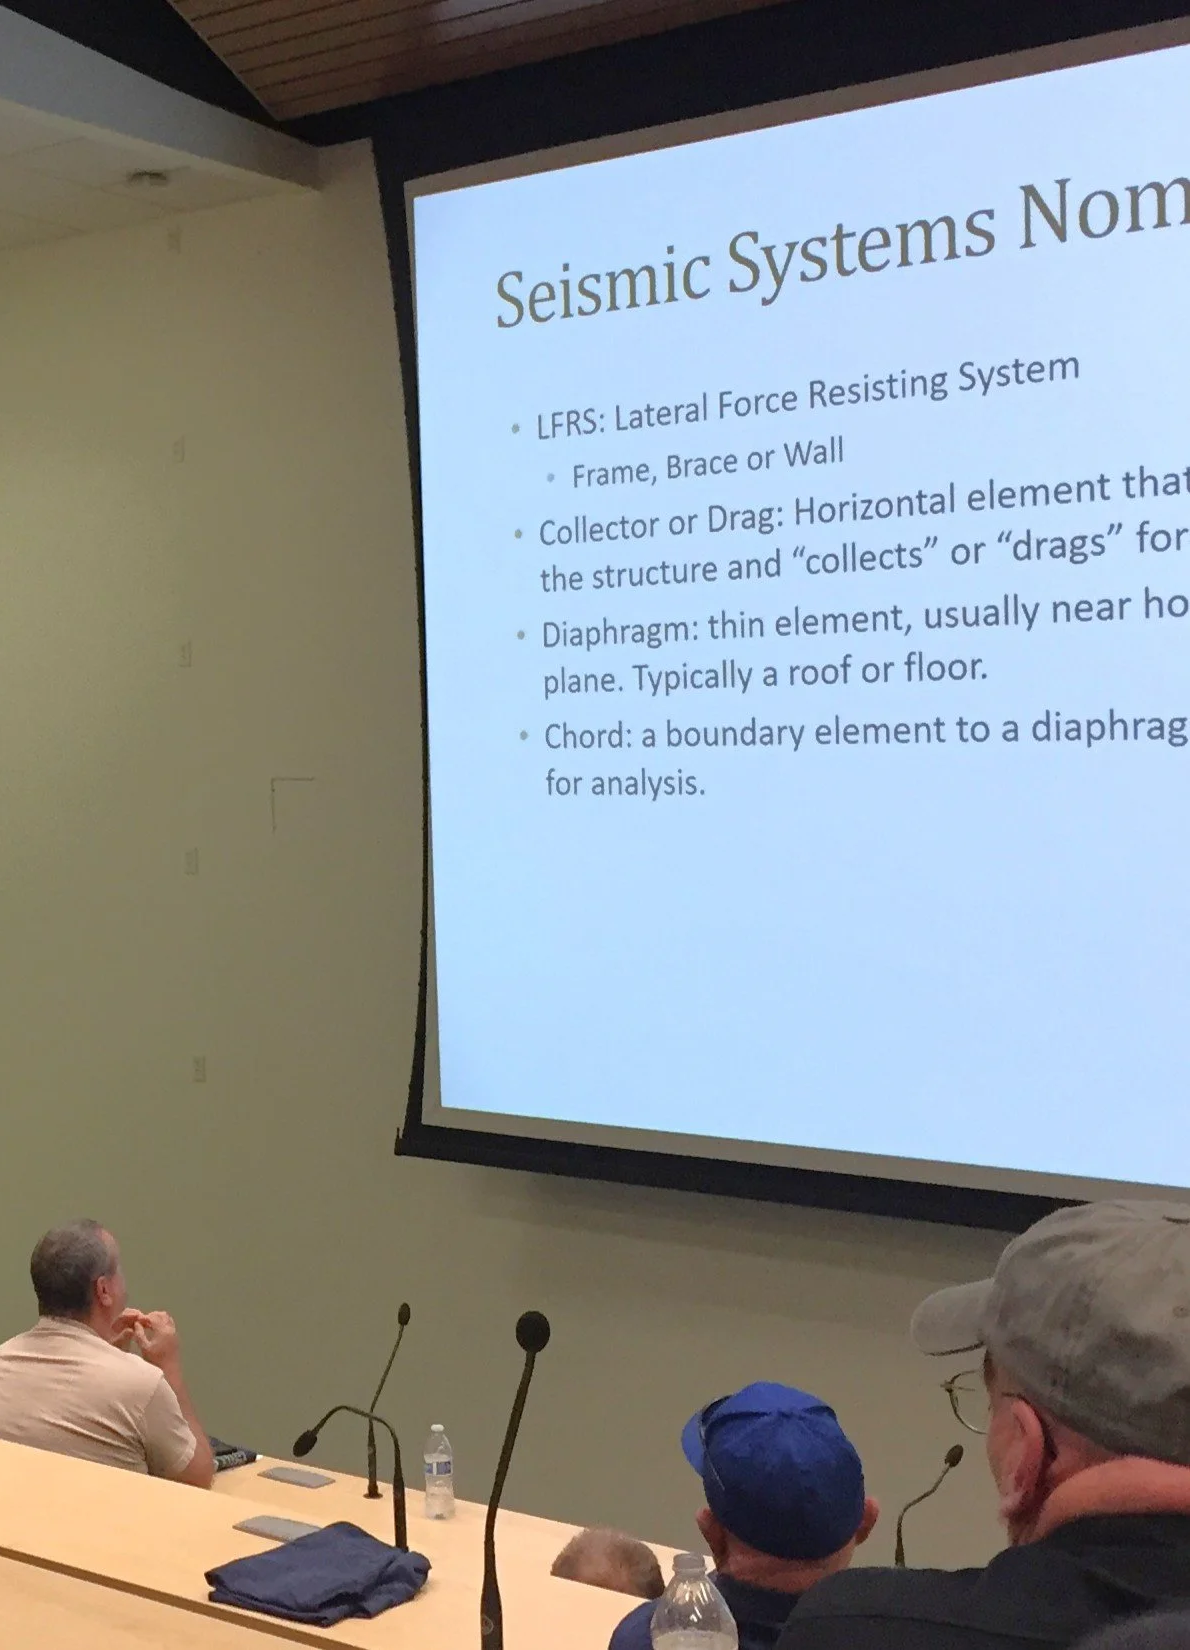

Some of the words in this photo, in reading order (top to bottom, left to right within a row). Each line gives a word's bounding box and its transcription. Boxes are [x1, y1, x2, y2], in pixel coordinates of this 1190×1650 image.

[496, 244, 711, 329] Seismic
[728, 208, 996, 307] Systems
[1018, 176, 1190, 250] Nom
[537, 407, 606, 441] LFRS:
[615, 391, 708, 432] Lateral
[718, 390, 798, 420] Force
[808, 368, 949, 410] Resisting
[957, 356, 1080, 397] System
[573, 462, 657, 489] Frame,
[666, 453, 739, 480] Brace
[746, 448, 777, 472] or
[783, 434, 844, 468] Wall
[539, 514, 661, 547] Collector
[668, 513, 699, 536] or
[707, 504, 784, 536] Drag:
[794, 481, 956, 526] Horizontal
[967, 472, 1112, 512] element
[1121, 464, 1190, 500] that
[539, 563, 584, 593] the
[592, 560, 718, 590] structure
[727, 547, 782, 581] and
[950, 541, 987, 566] or
[1135, 519, 1190, 554] for
[543, 616, 699, 653] Diaphragm:
[707, 608, 765, 640] thin
[774, 604, 912, 637] element,
[924, 592, 1041, 633] usually
[1052, 596, 1133, 624] near
[1143, 585, 1190, 620] ho
[544, 665, 624, 701] plane.
[631, 658, 754, 697] Typically
[762, 665, 779, 688] a
[789, 653, 853, 687] roof
[861, 661, 896, 684] or
[903, 650, 988, 683] floor.
[544, 719, 632, 750] Chord:
[641, 727, 657, 749] a
[666, 715, 806, 753] boundary
[814, 713, 947, 746] element
[955, 716, 991, 744] to
[1001, 719, 1020, 743] a
[1031, 707, 1189, 749] diaphrag
[545, 767, 584, 797] for
[591, 767, 706, 803] analysis.
